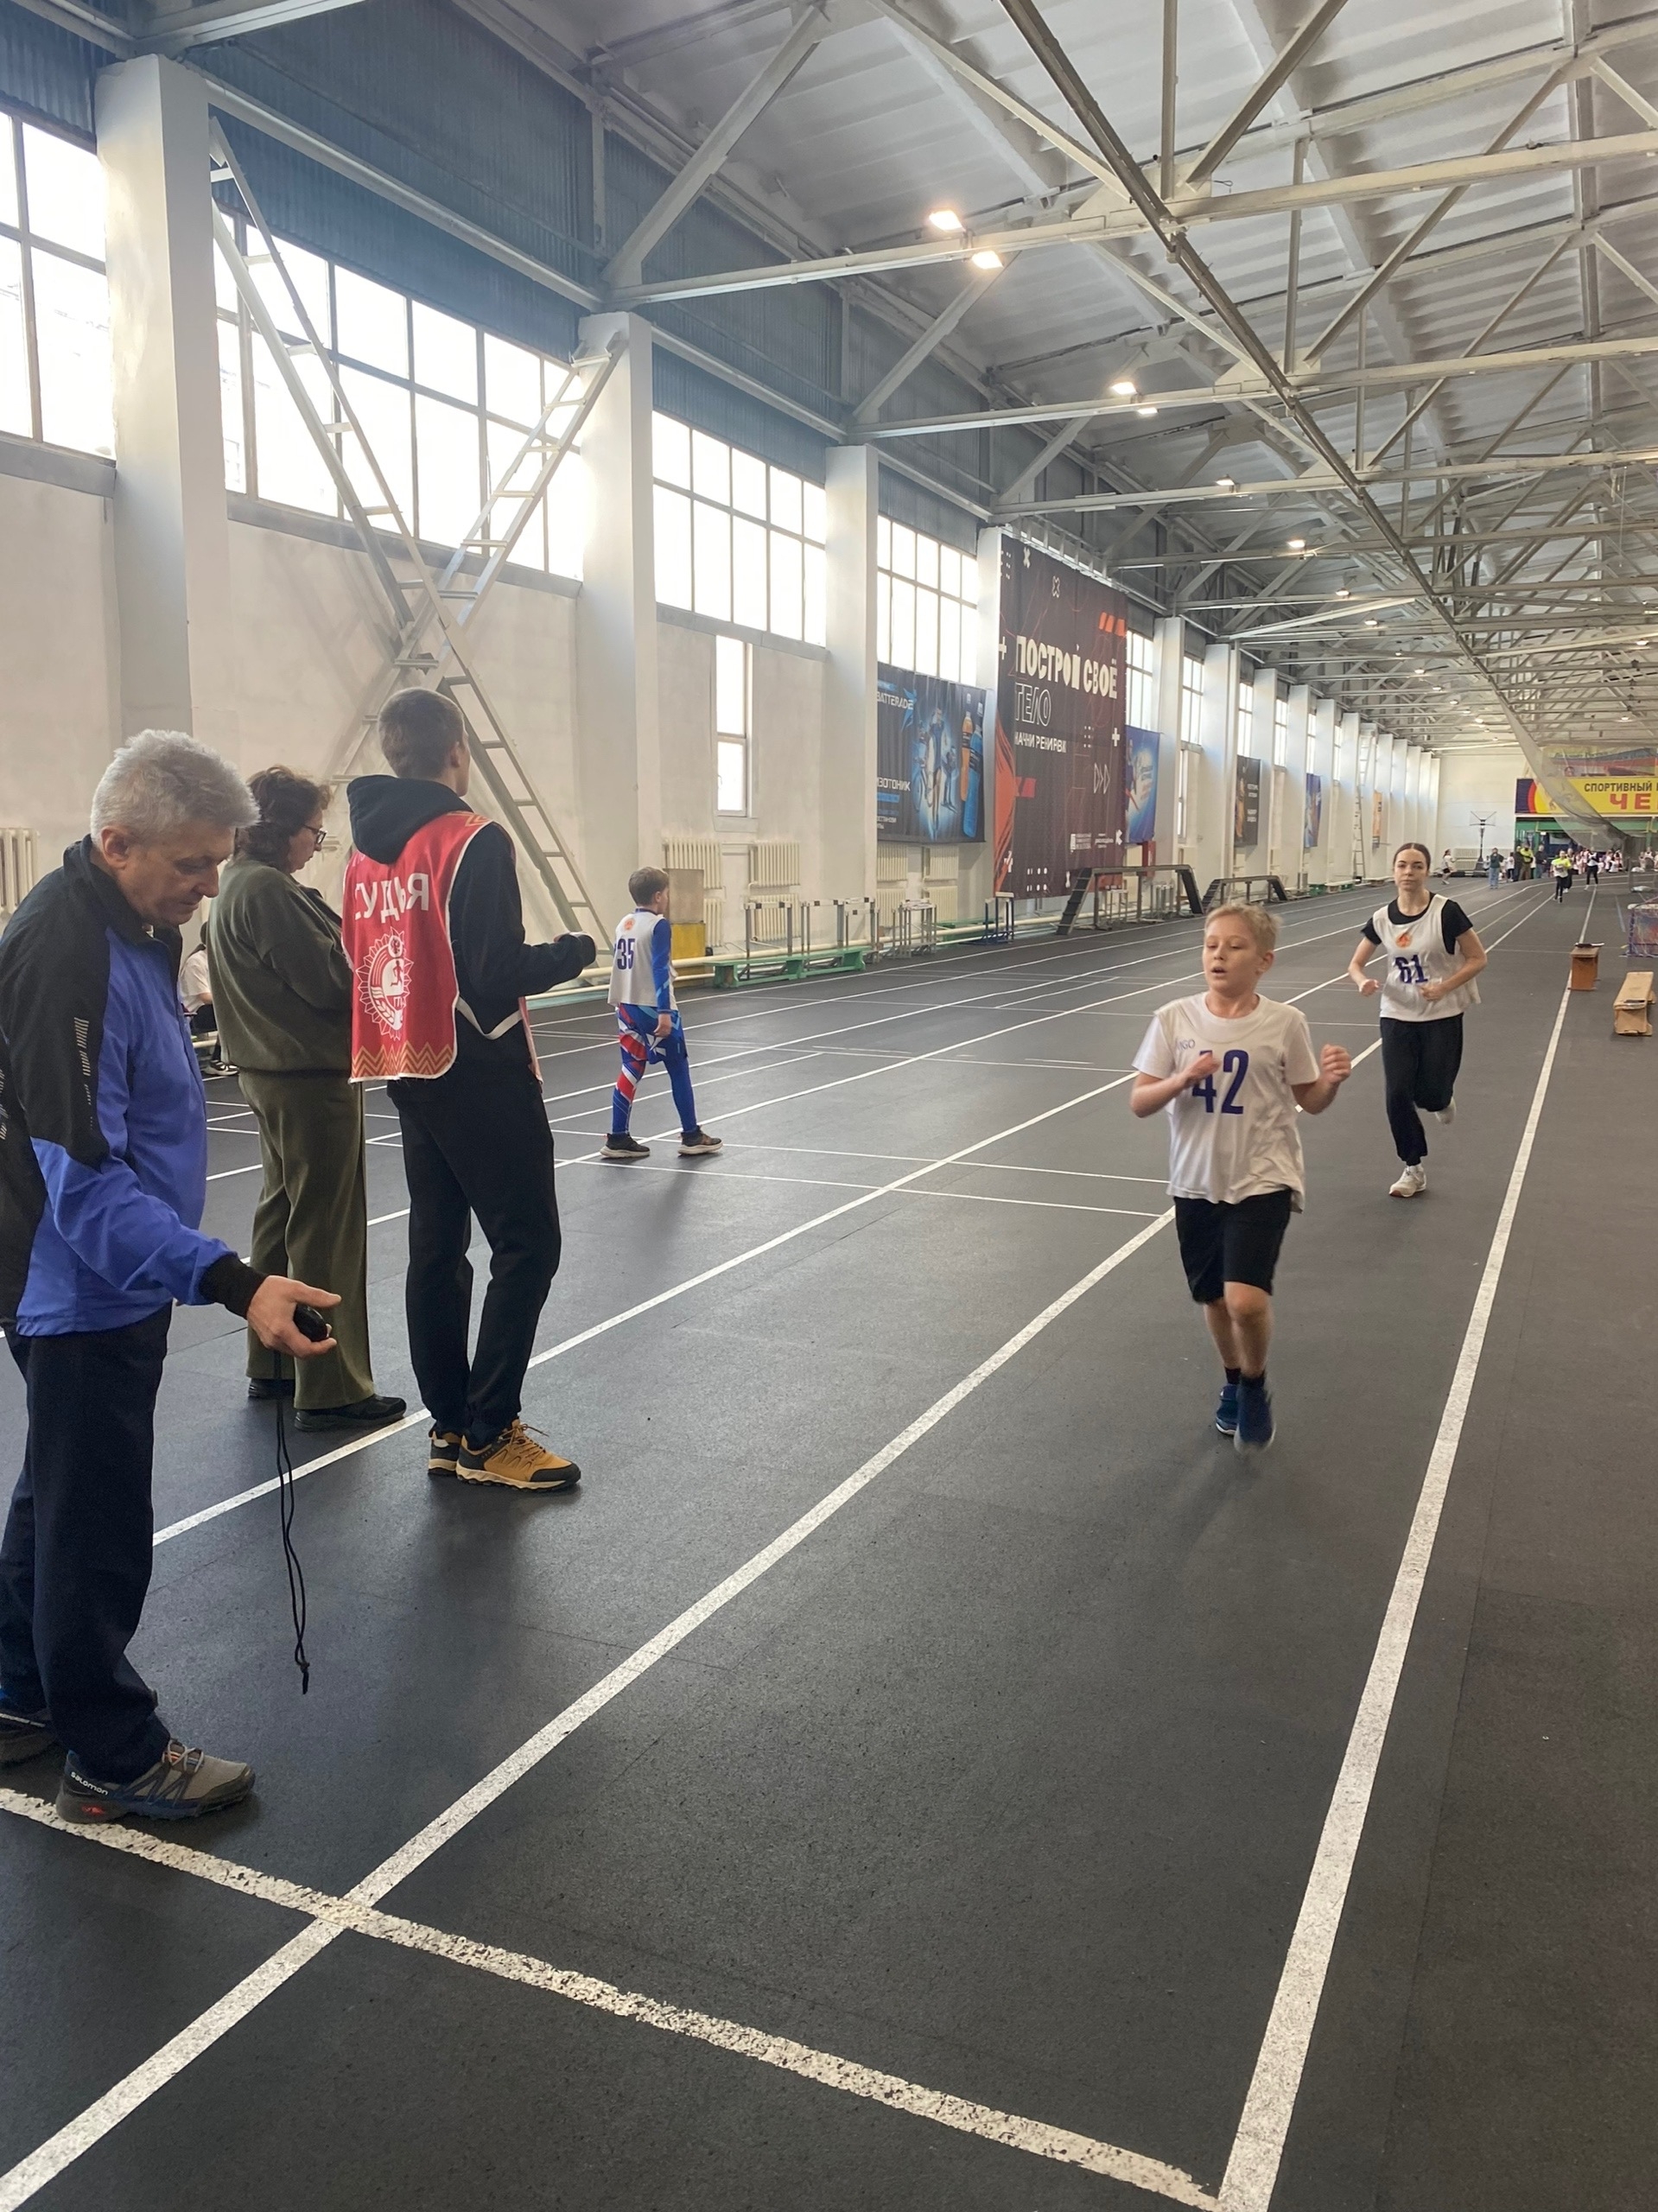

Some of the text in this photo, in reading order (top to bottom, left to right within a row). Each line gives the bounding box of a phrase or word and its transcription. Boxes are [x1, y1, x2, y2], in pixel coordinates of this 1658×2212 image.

[1083, 658, 1118, 699] СВОЁ
[1015, 682, 1051, 727] ТЕЛО
[877, 777, 911, 791] ЗОТОНИК
[1584, 781, 1653, 792] СПОРТИВНЫЙ
[1610, 793, 1658, 810] ЧЕ
[617, 938, 636, 970] 35
[1394, 954, 1429, 984] 61
[1191, 1049, 1249, 1115] 42
